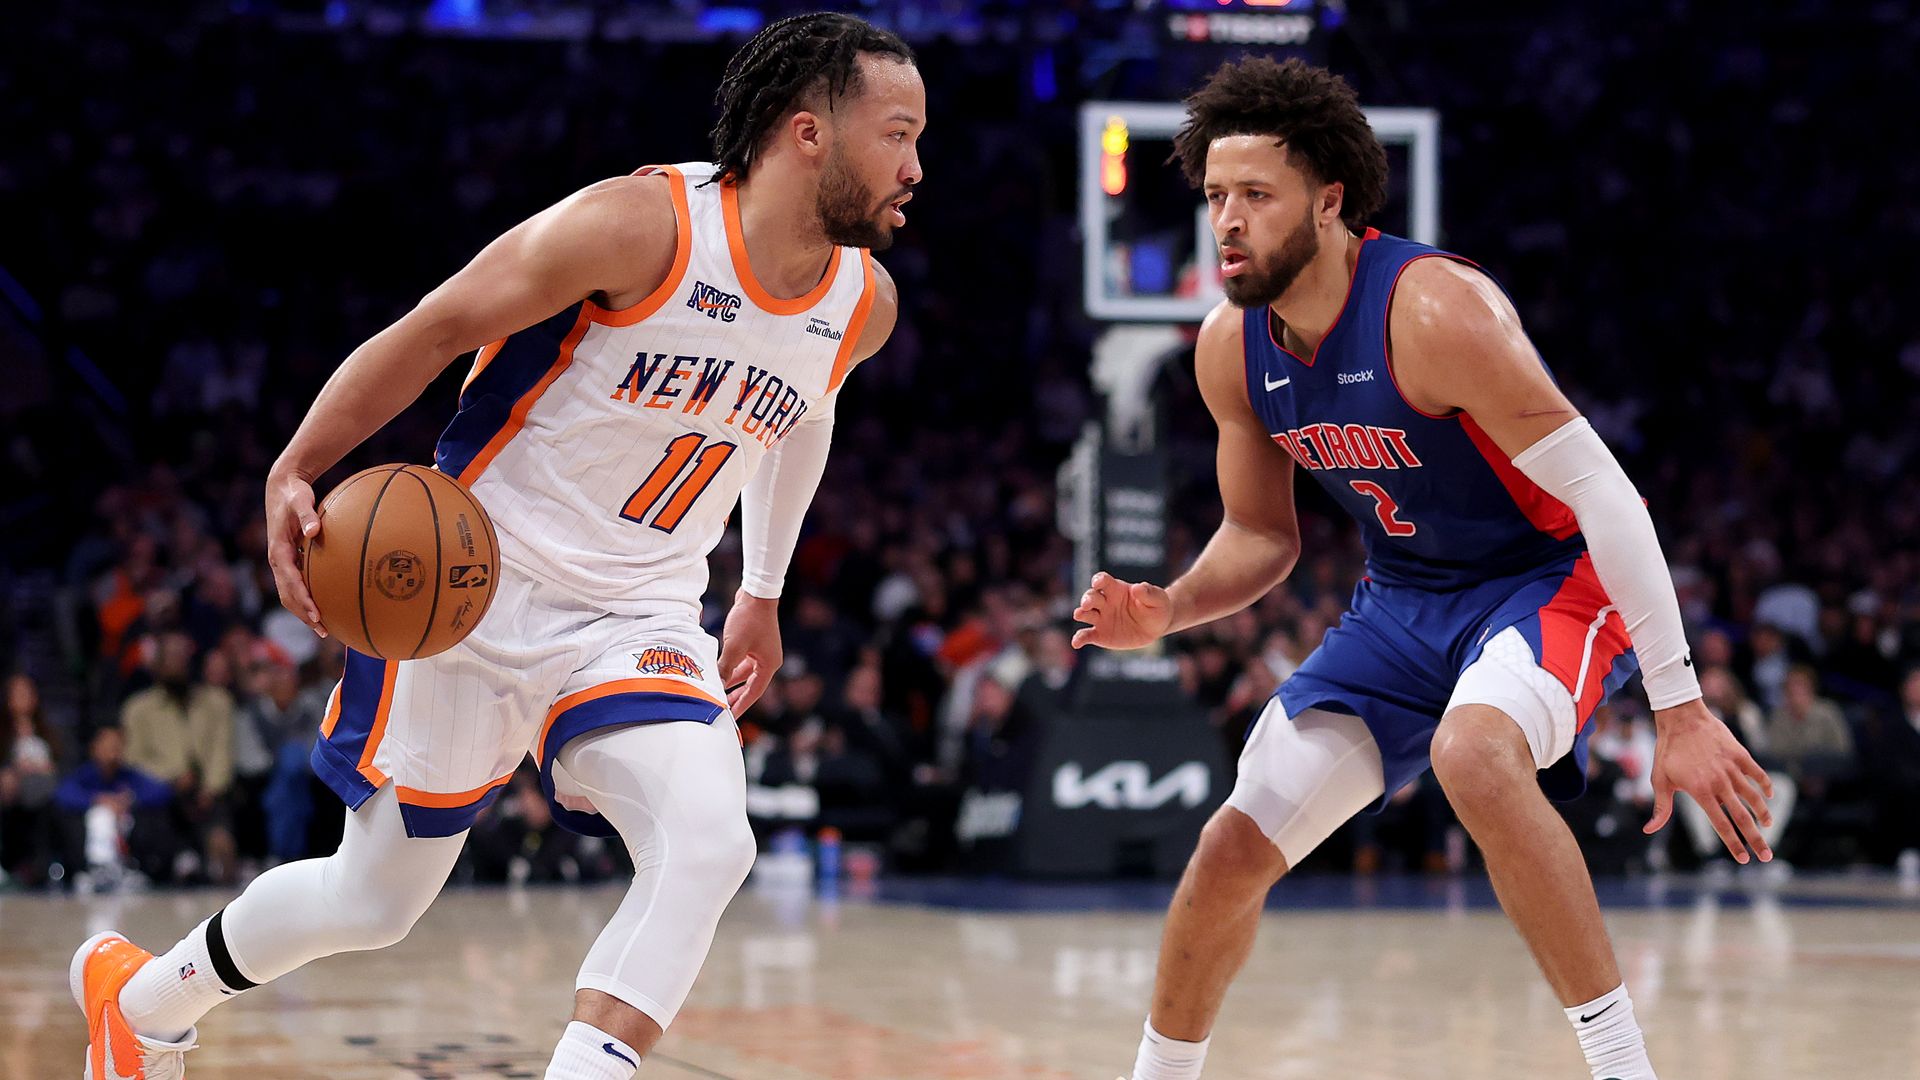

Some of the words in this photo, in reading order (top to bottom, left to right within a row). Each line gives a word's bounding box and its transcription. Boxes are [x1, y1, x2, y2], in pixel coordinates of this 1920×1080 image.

[687, 281, 741, 322] NYC
[806, 323, 821, 335] abu
[821, 327, 843, 340] dhabi
[616, 352, 734, 402] NEW
[732, 365, 808, 440] YORK
[1337, 369, 1375, 386] StockX
[1270, 423, 1423, 470] DETROIT
[619, 432, 737, 534] 11
[1350, 480, 1416, 536] 2
[636, 648, 704, 681] KNICKS
